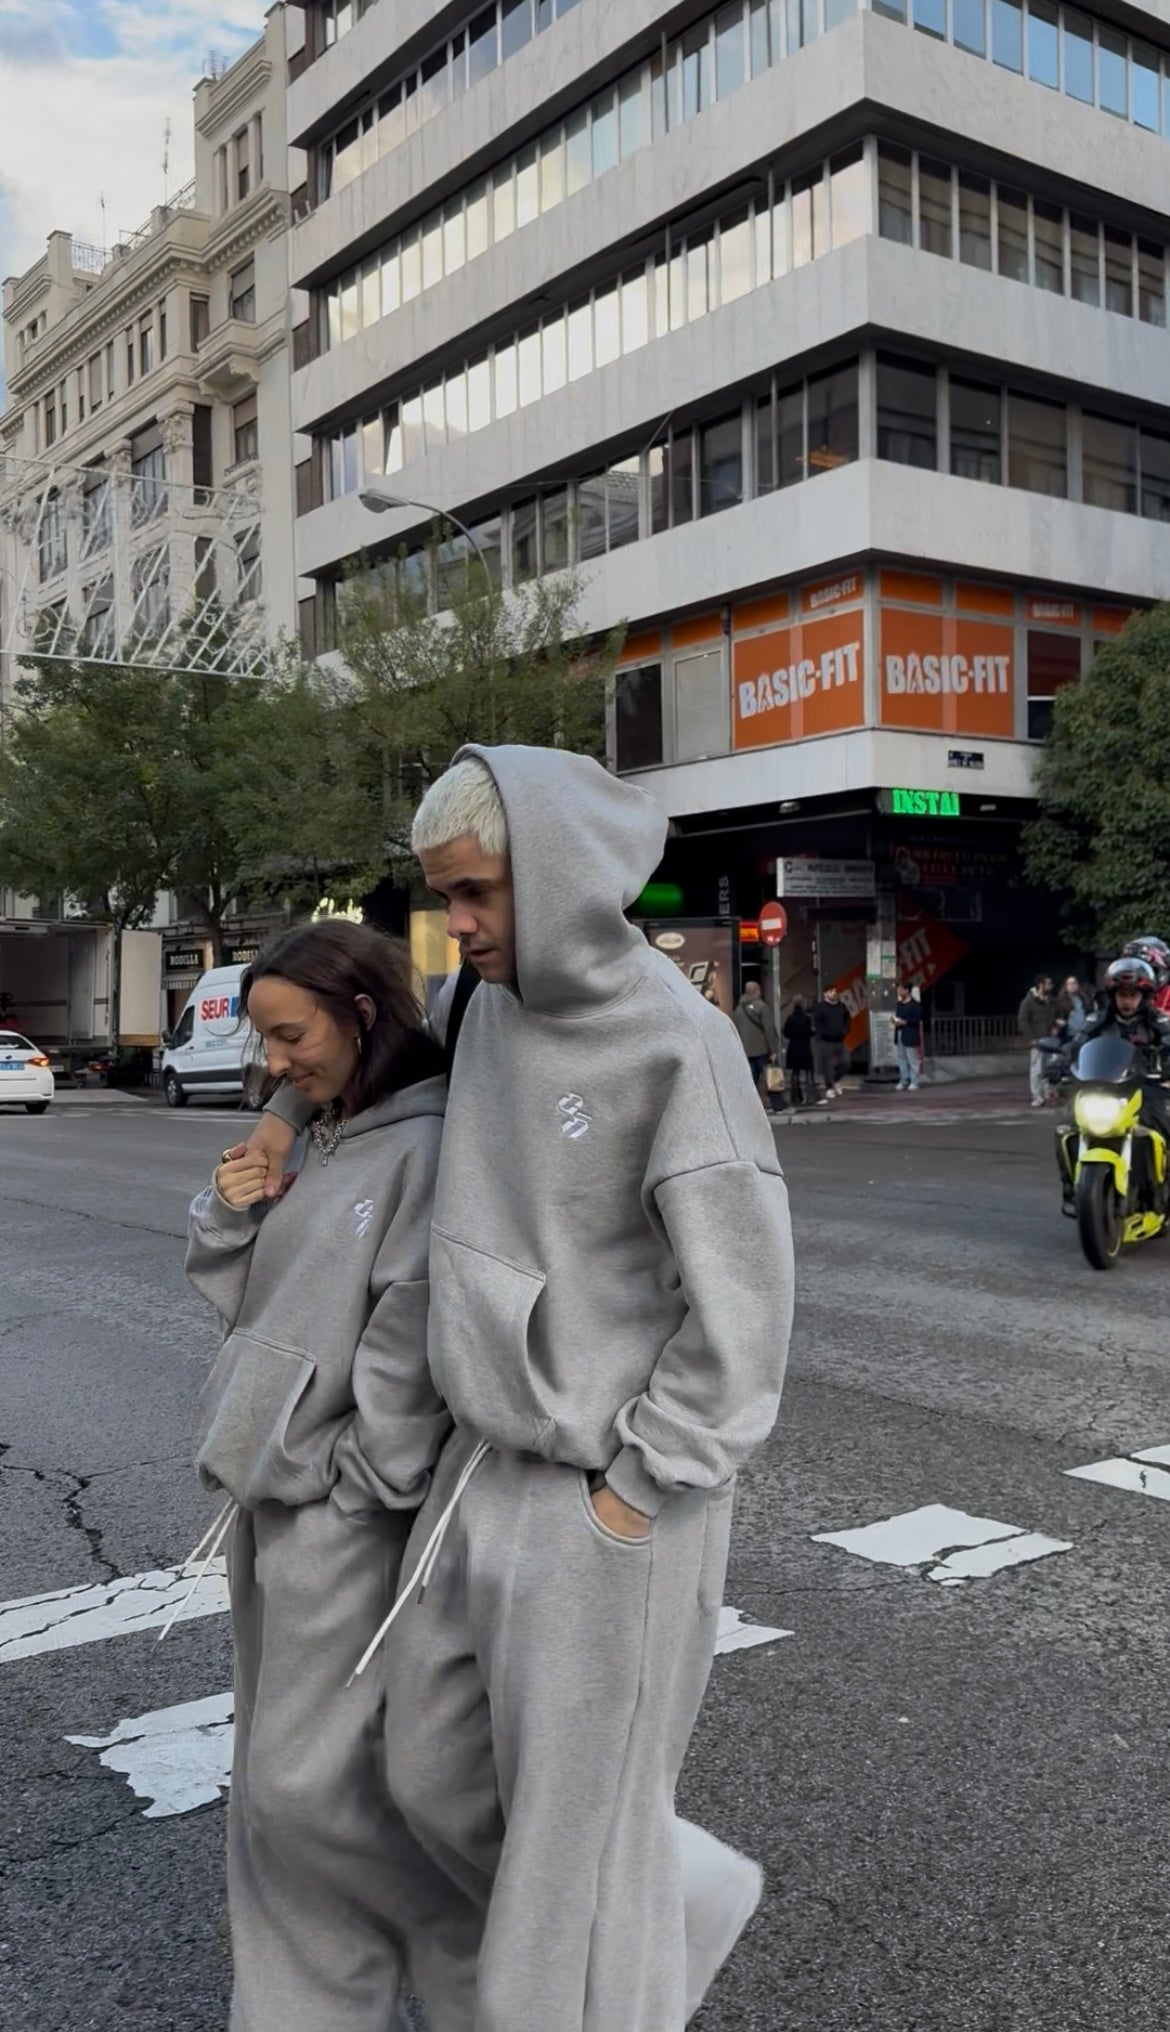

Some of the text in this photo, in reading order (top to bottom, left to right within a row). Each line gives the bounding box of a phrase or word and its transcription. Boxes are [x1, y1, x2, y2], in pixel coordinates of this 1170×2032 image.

[810, 577, 857, 608] BASIC-FIT
[739, 641, 860, 719] BASIC-FIT
[885, 652, 1010, 694] BASIC-FIT
[201, 997, 230, 1021] SEUR
